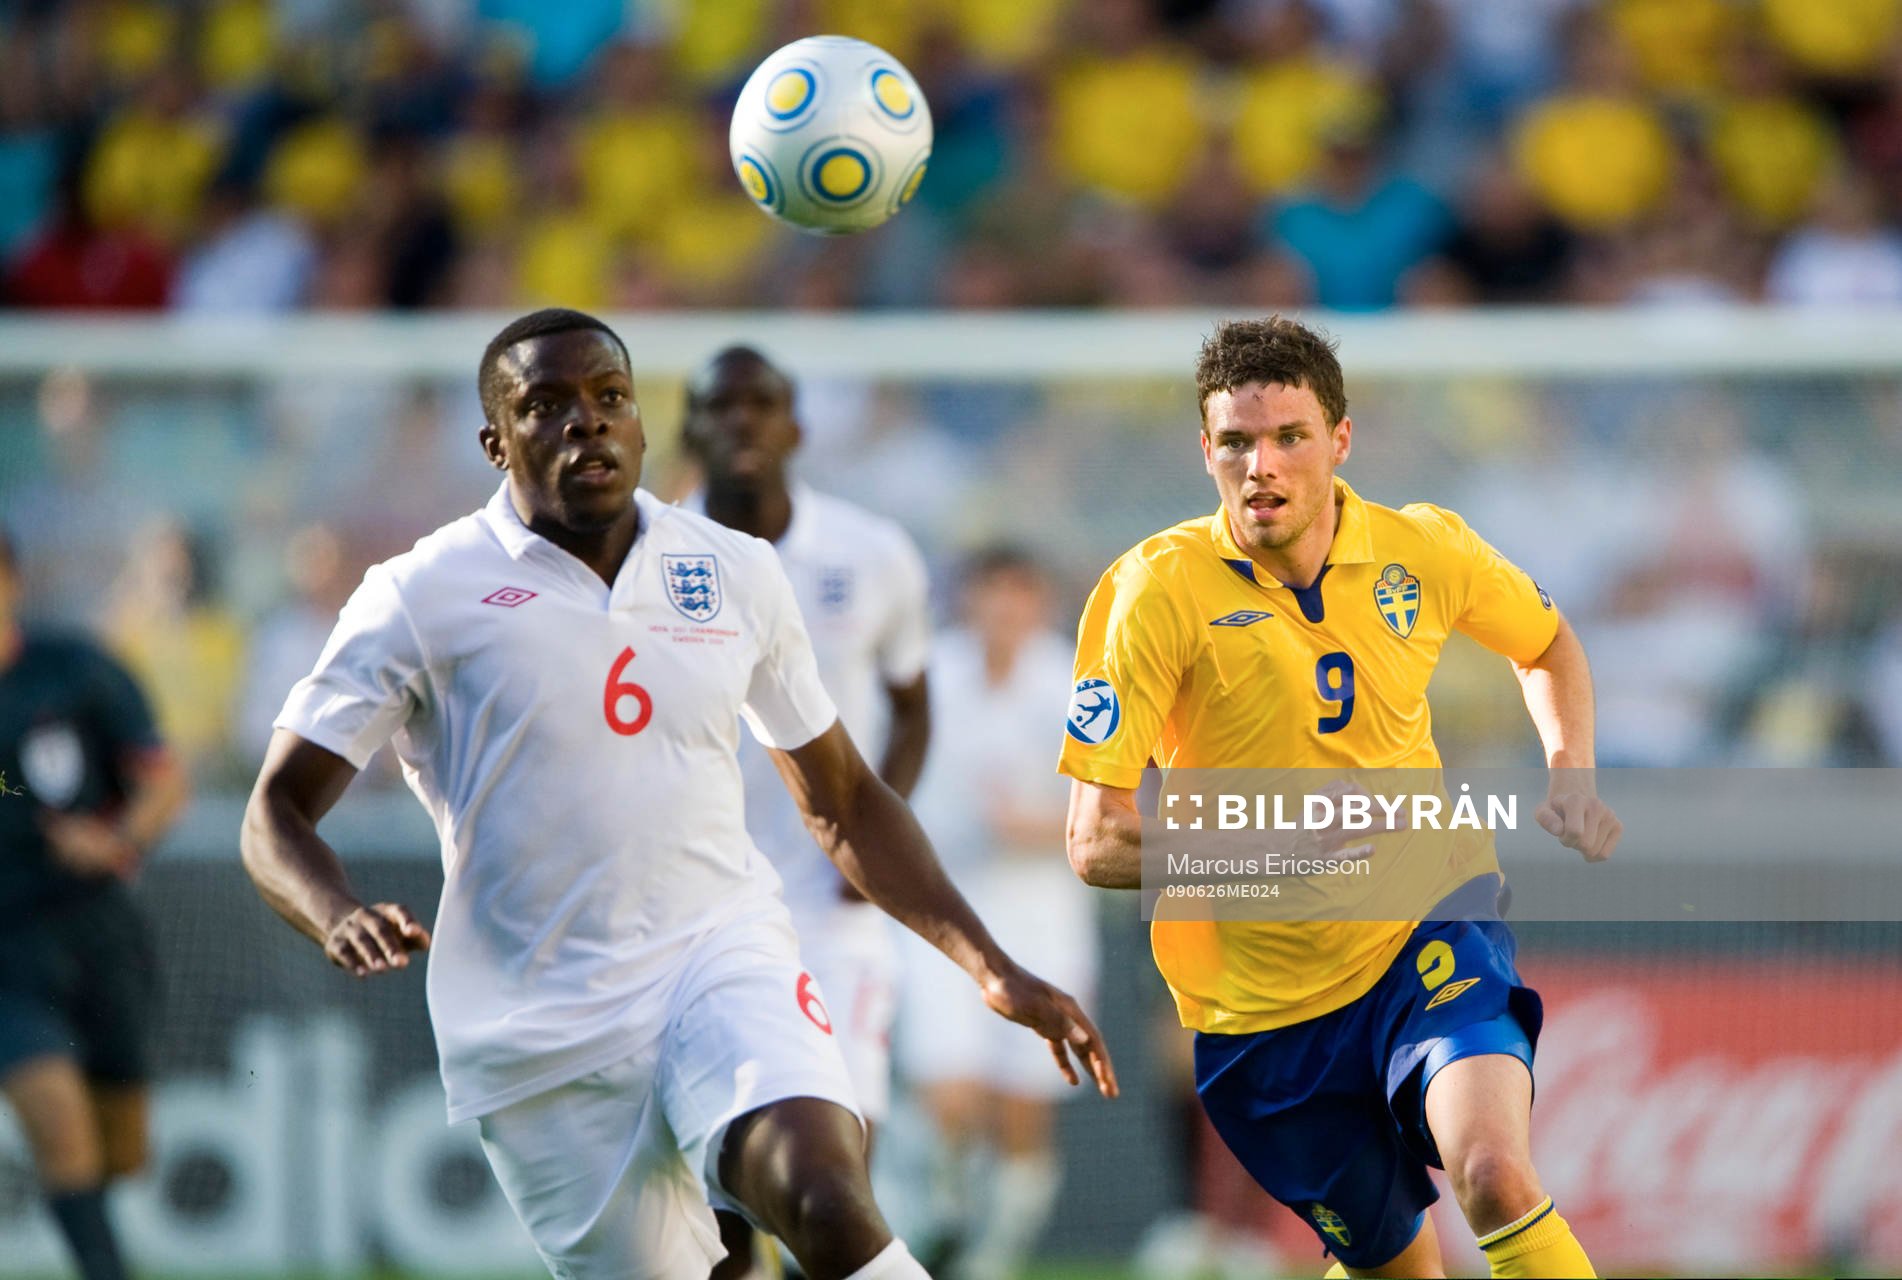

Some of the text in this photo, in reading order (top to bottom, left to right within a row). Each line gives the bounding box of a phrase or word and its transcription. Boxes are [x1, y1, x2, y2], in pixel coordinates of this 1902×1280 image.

[603, 645, 653, 737] 6
[1316, 652, 1355, 734] 9
[796, 972, 833, 1035] 6
